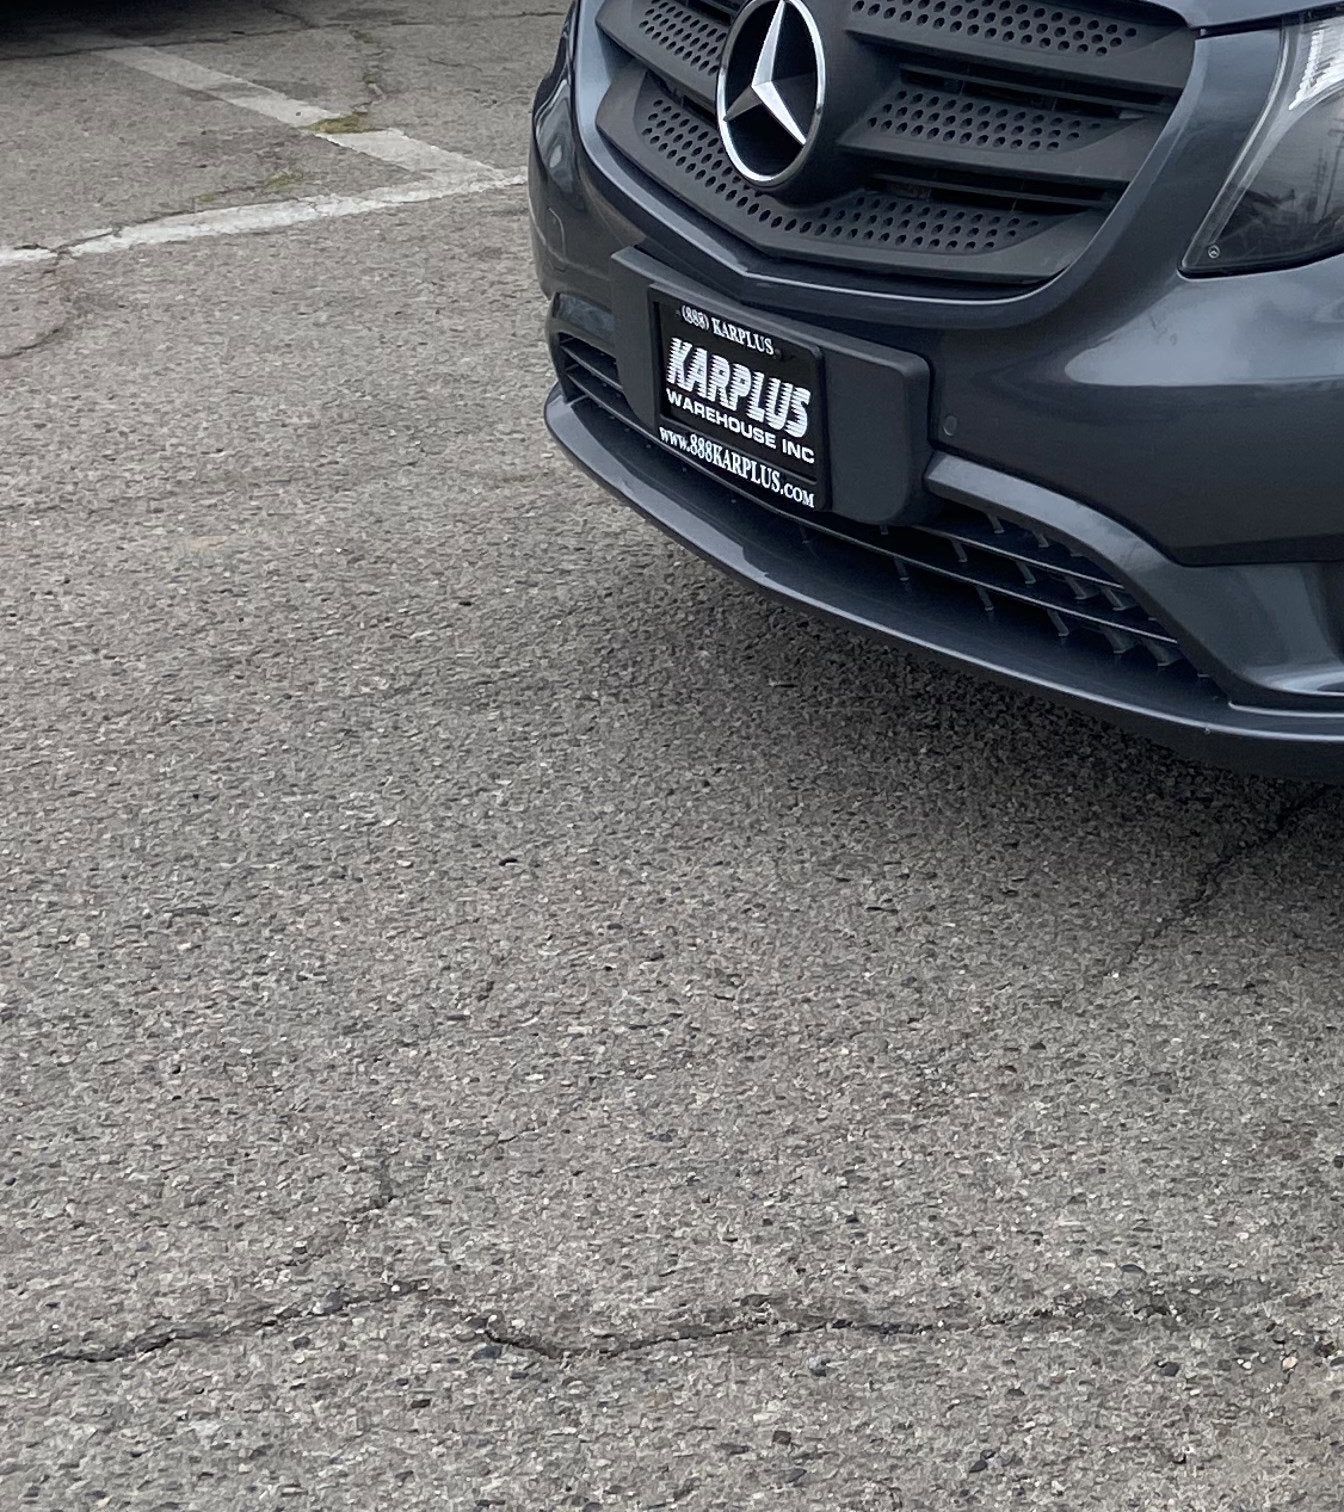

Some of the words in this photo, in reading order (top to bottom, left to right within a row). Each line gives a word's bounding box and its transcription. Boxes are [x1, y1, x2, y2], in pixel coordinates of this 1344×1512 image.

[681, 304, 710, 330] (888)
[711, 317, 775, 356] KARPLUS
[665, 337, 811, 438] KARPLUS
[666, 388, 777, 449] WAREHOUSE
[782, 438, 815, 465] INC
